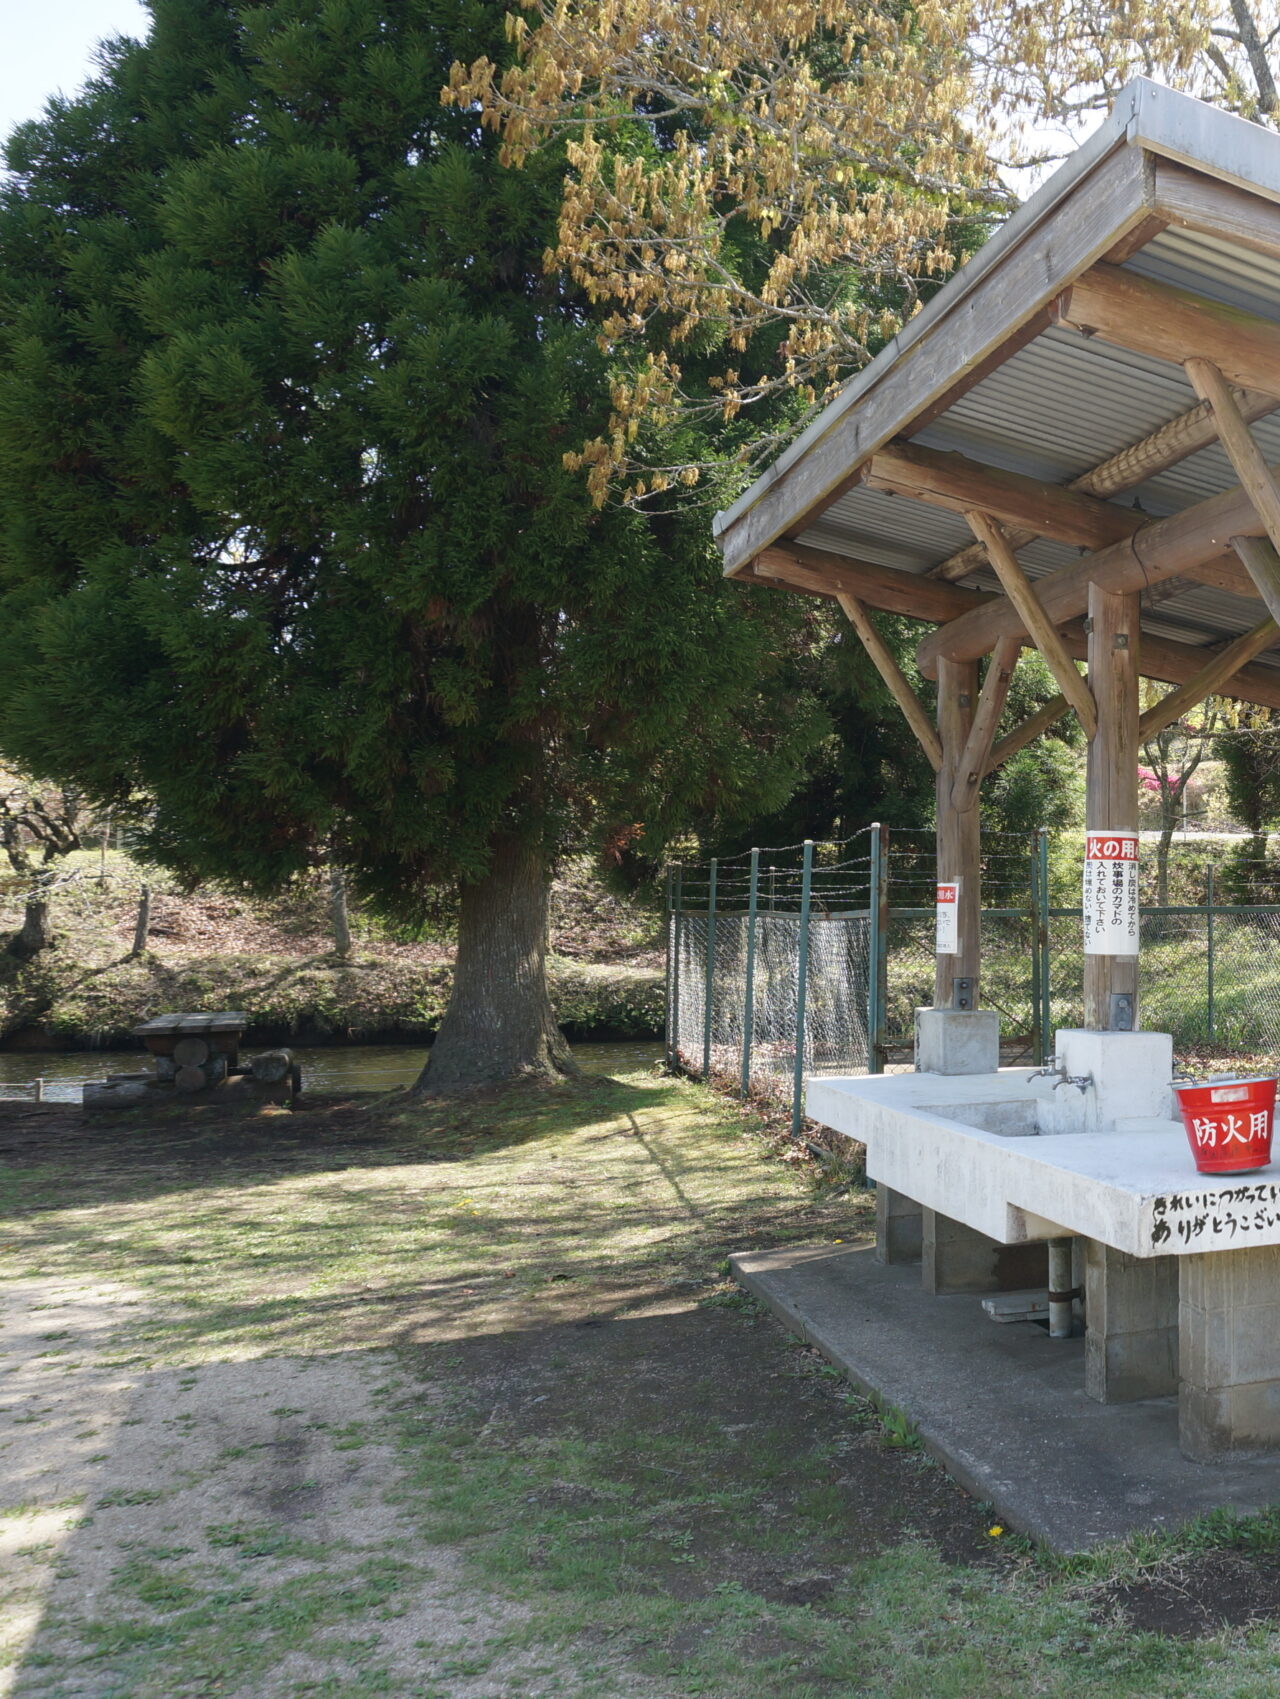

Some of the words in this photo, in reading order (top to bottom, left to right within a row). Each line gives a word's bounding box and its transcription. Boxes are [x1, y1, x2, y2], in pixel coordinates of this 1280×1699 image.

[1089, 839, 1139, 858] 火の用
[1095, 861, 1108, 934] 入れておいて下さい
[1111, 861, 1124, 926] 炊事場のカマドの
[1191, 1109, 1269, 1148] 防火用
